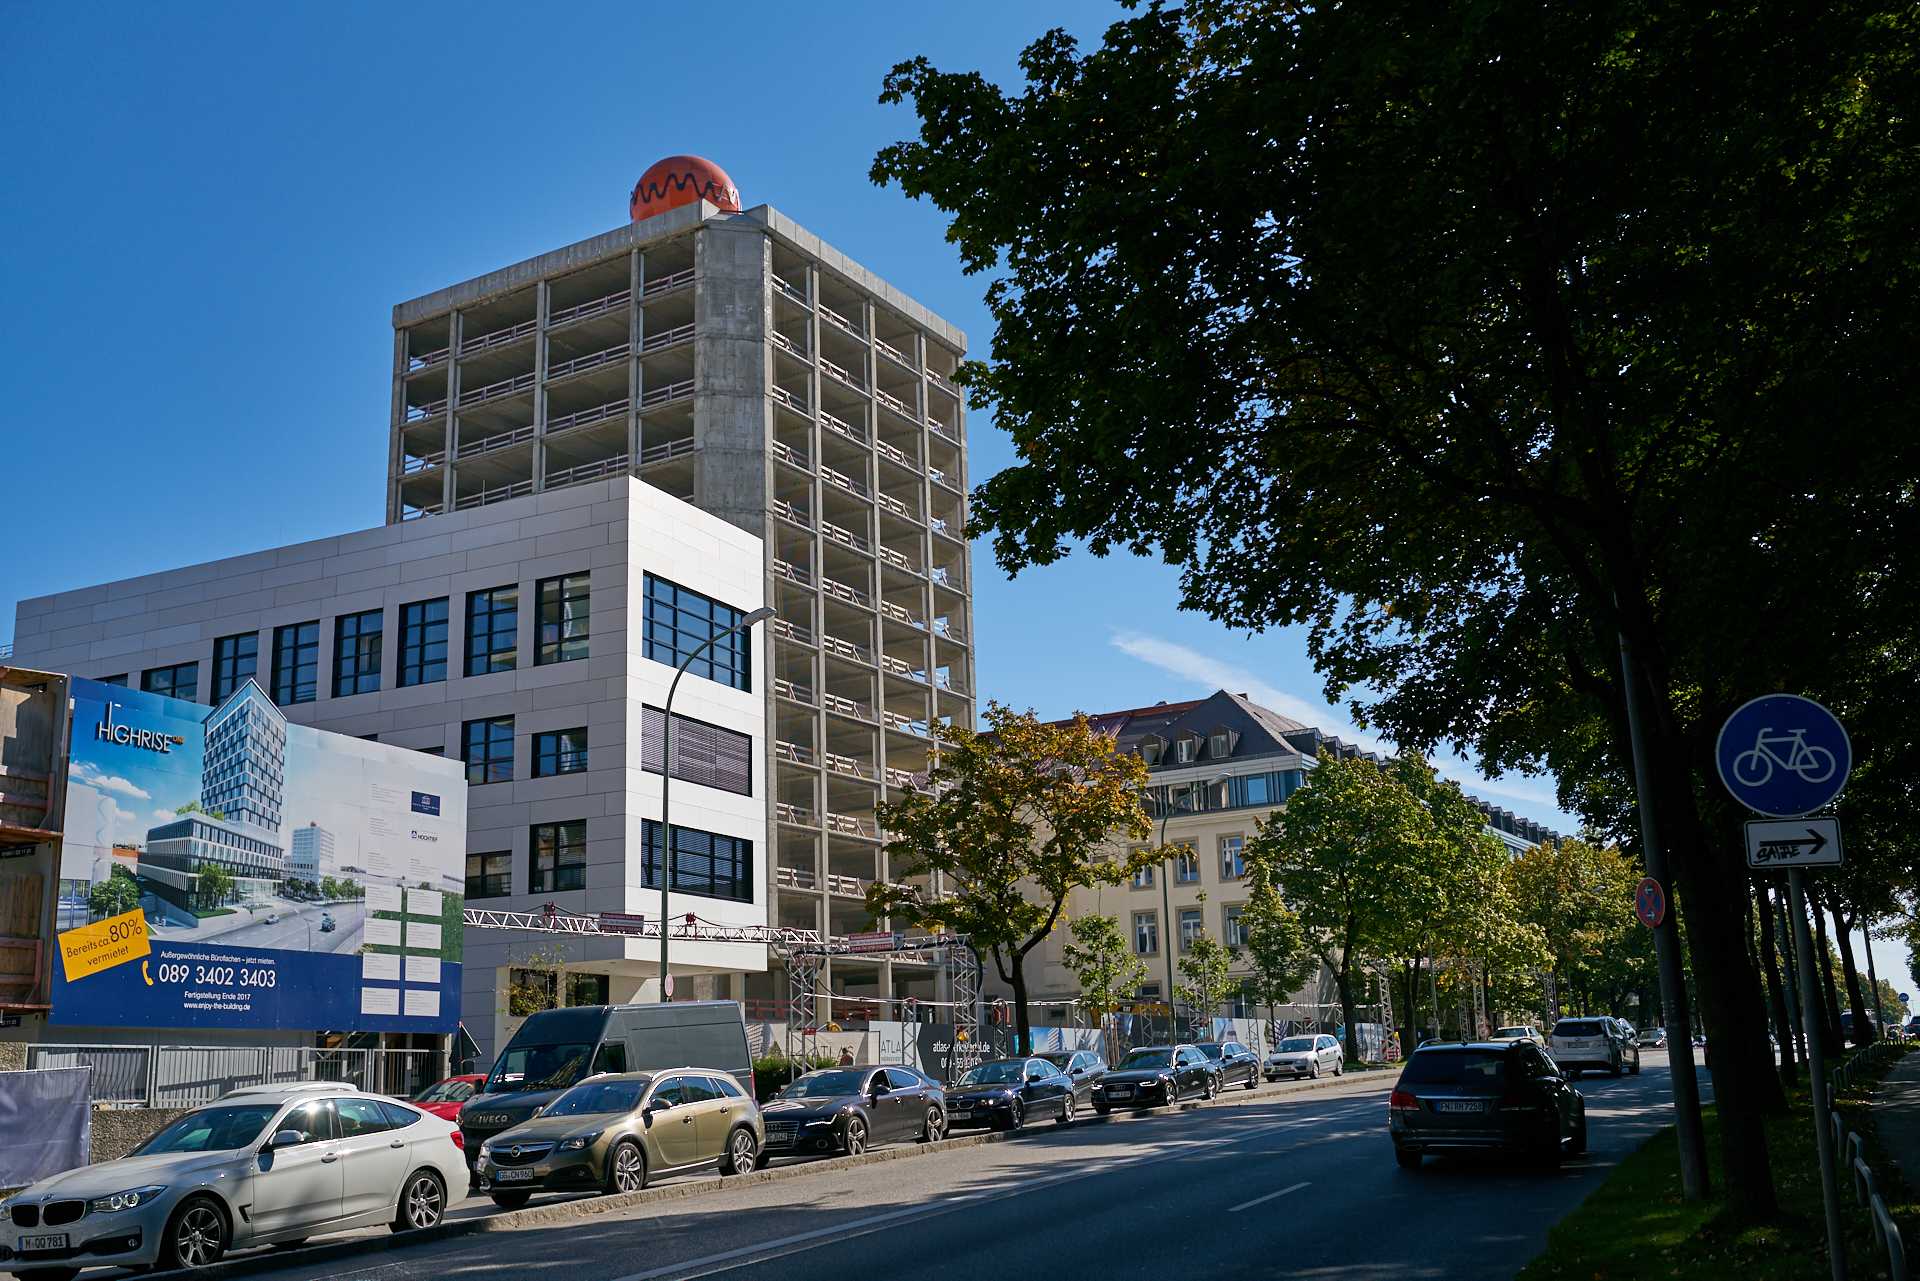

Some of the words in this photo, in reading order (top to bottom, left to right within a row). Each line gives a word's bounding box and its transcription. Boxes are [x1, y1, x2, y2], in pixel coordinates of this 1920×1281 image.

[98, 701, 172, 753] HIGHRISE
[172, 736, 184, 744] ONE
[66, 941, 98, 958] Bereits
[98, 938, 110, 947] ca.
[110, 918, 142, 942] 80%
[87, 945, 128, 966] vermietet
[161, 951, 210, 962] Außergewöhnliche
[159, 964, 189, 983] 089
[196, 966, 234, 985] 3402
[239, 968, 276, 987] 3403
[184, 991, 220, 1001] Fertigstellung
[184, 1002, 250, 1011] www.enjoy-the-building.de
[881, 1040, 902, 1053] ATLA
[479, 1115, 508, 1123] IVECO
[500, 1171, 507, 1179] GG
[510, 1170, 520, 1178] CN
[520, 1169, 532, 1178] 960
[35, 1238, 45, 1248] QQ
[47, 1236, 63, 1247] 781
